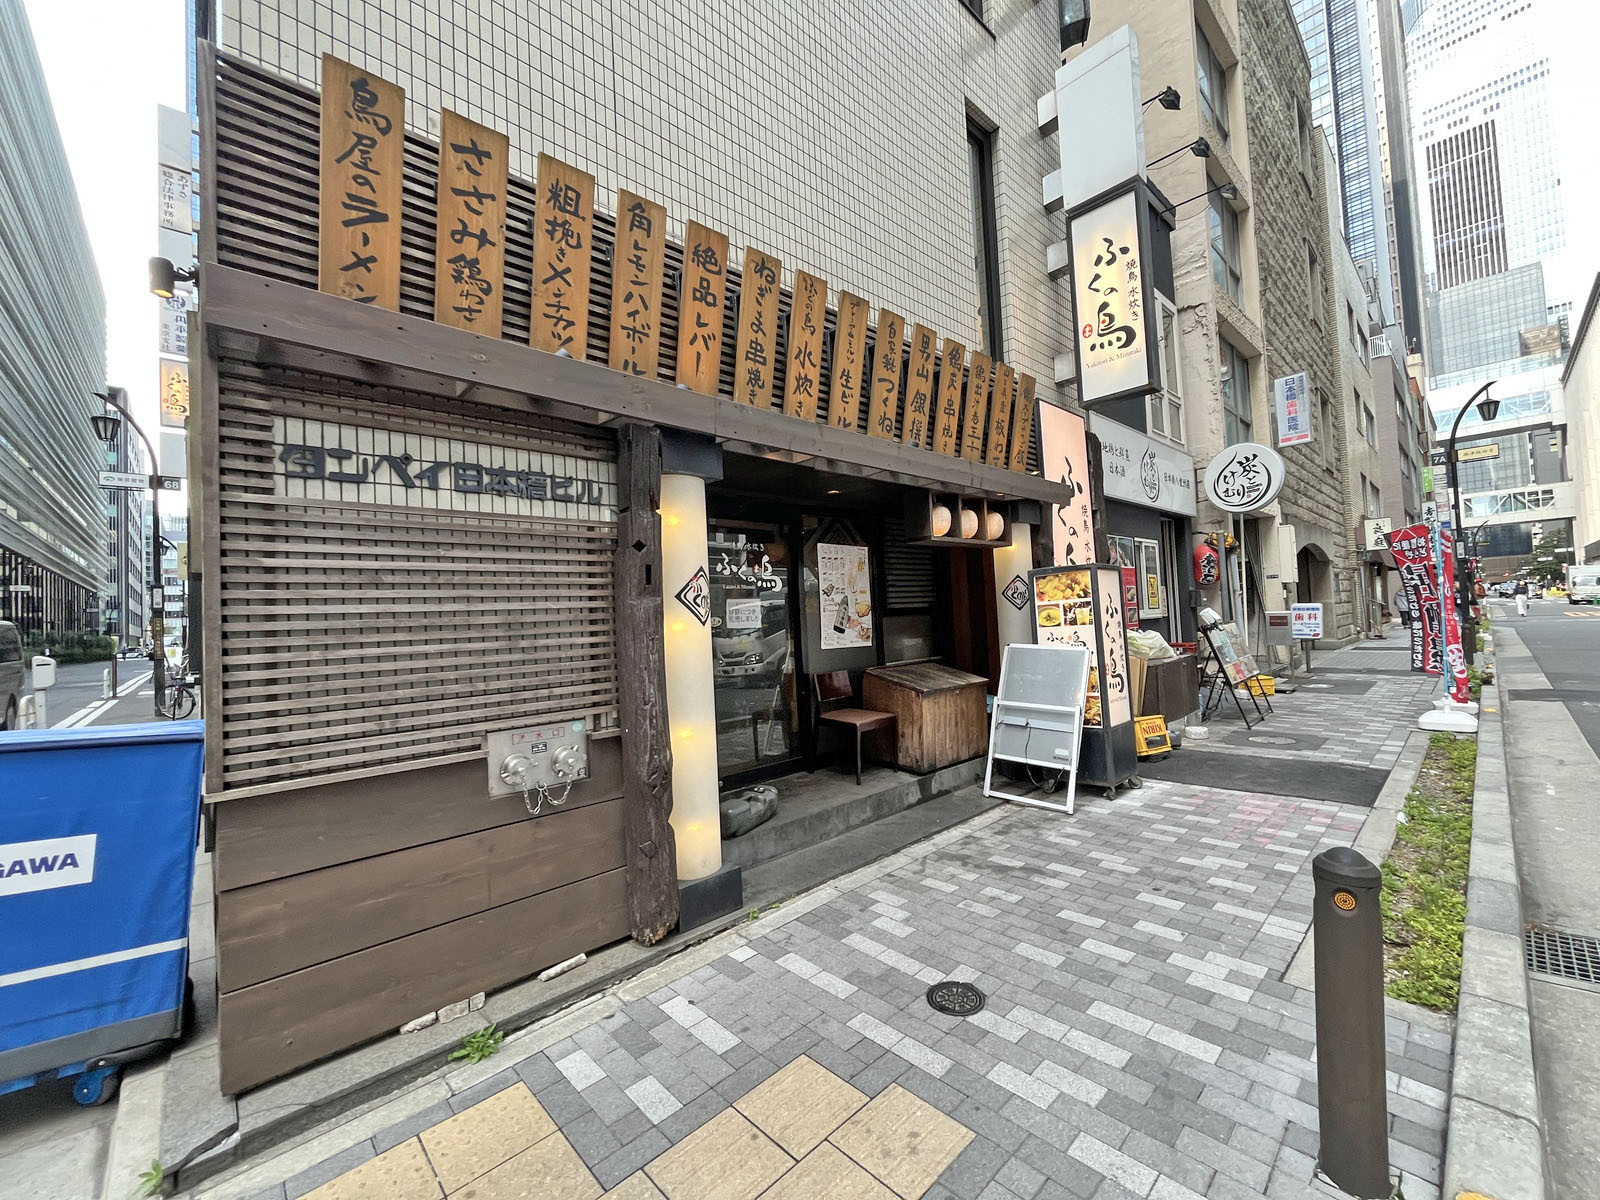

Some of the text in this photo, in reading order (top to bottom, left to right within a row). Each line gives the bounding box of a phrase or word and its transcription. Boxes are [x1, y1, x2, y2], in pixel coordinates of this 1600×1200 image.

[541, 177, 587, 347] 粗挽きメンチカツ
[620, 202, 653, 377] 角レモンハイボール
[689, 243, 722, 378] 絶品レバー
[1088, 237, 1137, 352] ふくの鳥
[745, 256, 777, 404] ねぎま串焼き
[1285, 377, 1300, 432] 日本橋歯科医院
[164, 481, 179, 489] 68
[279, 443, 603, 505] タンペイ日本橋ビル
[716, 552, 782, 592] ふくの鳥
[1105, 592, 1125, 693] ふくの鳥
[1295, 612, 1318, 622] 歯科
[1142, 723, 1163, 736] KIRIN
[0, 852, 80, 879] AWA
